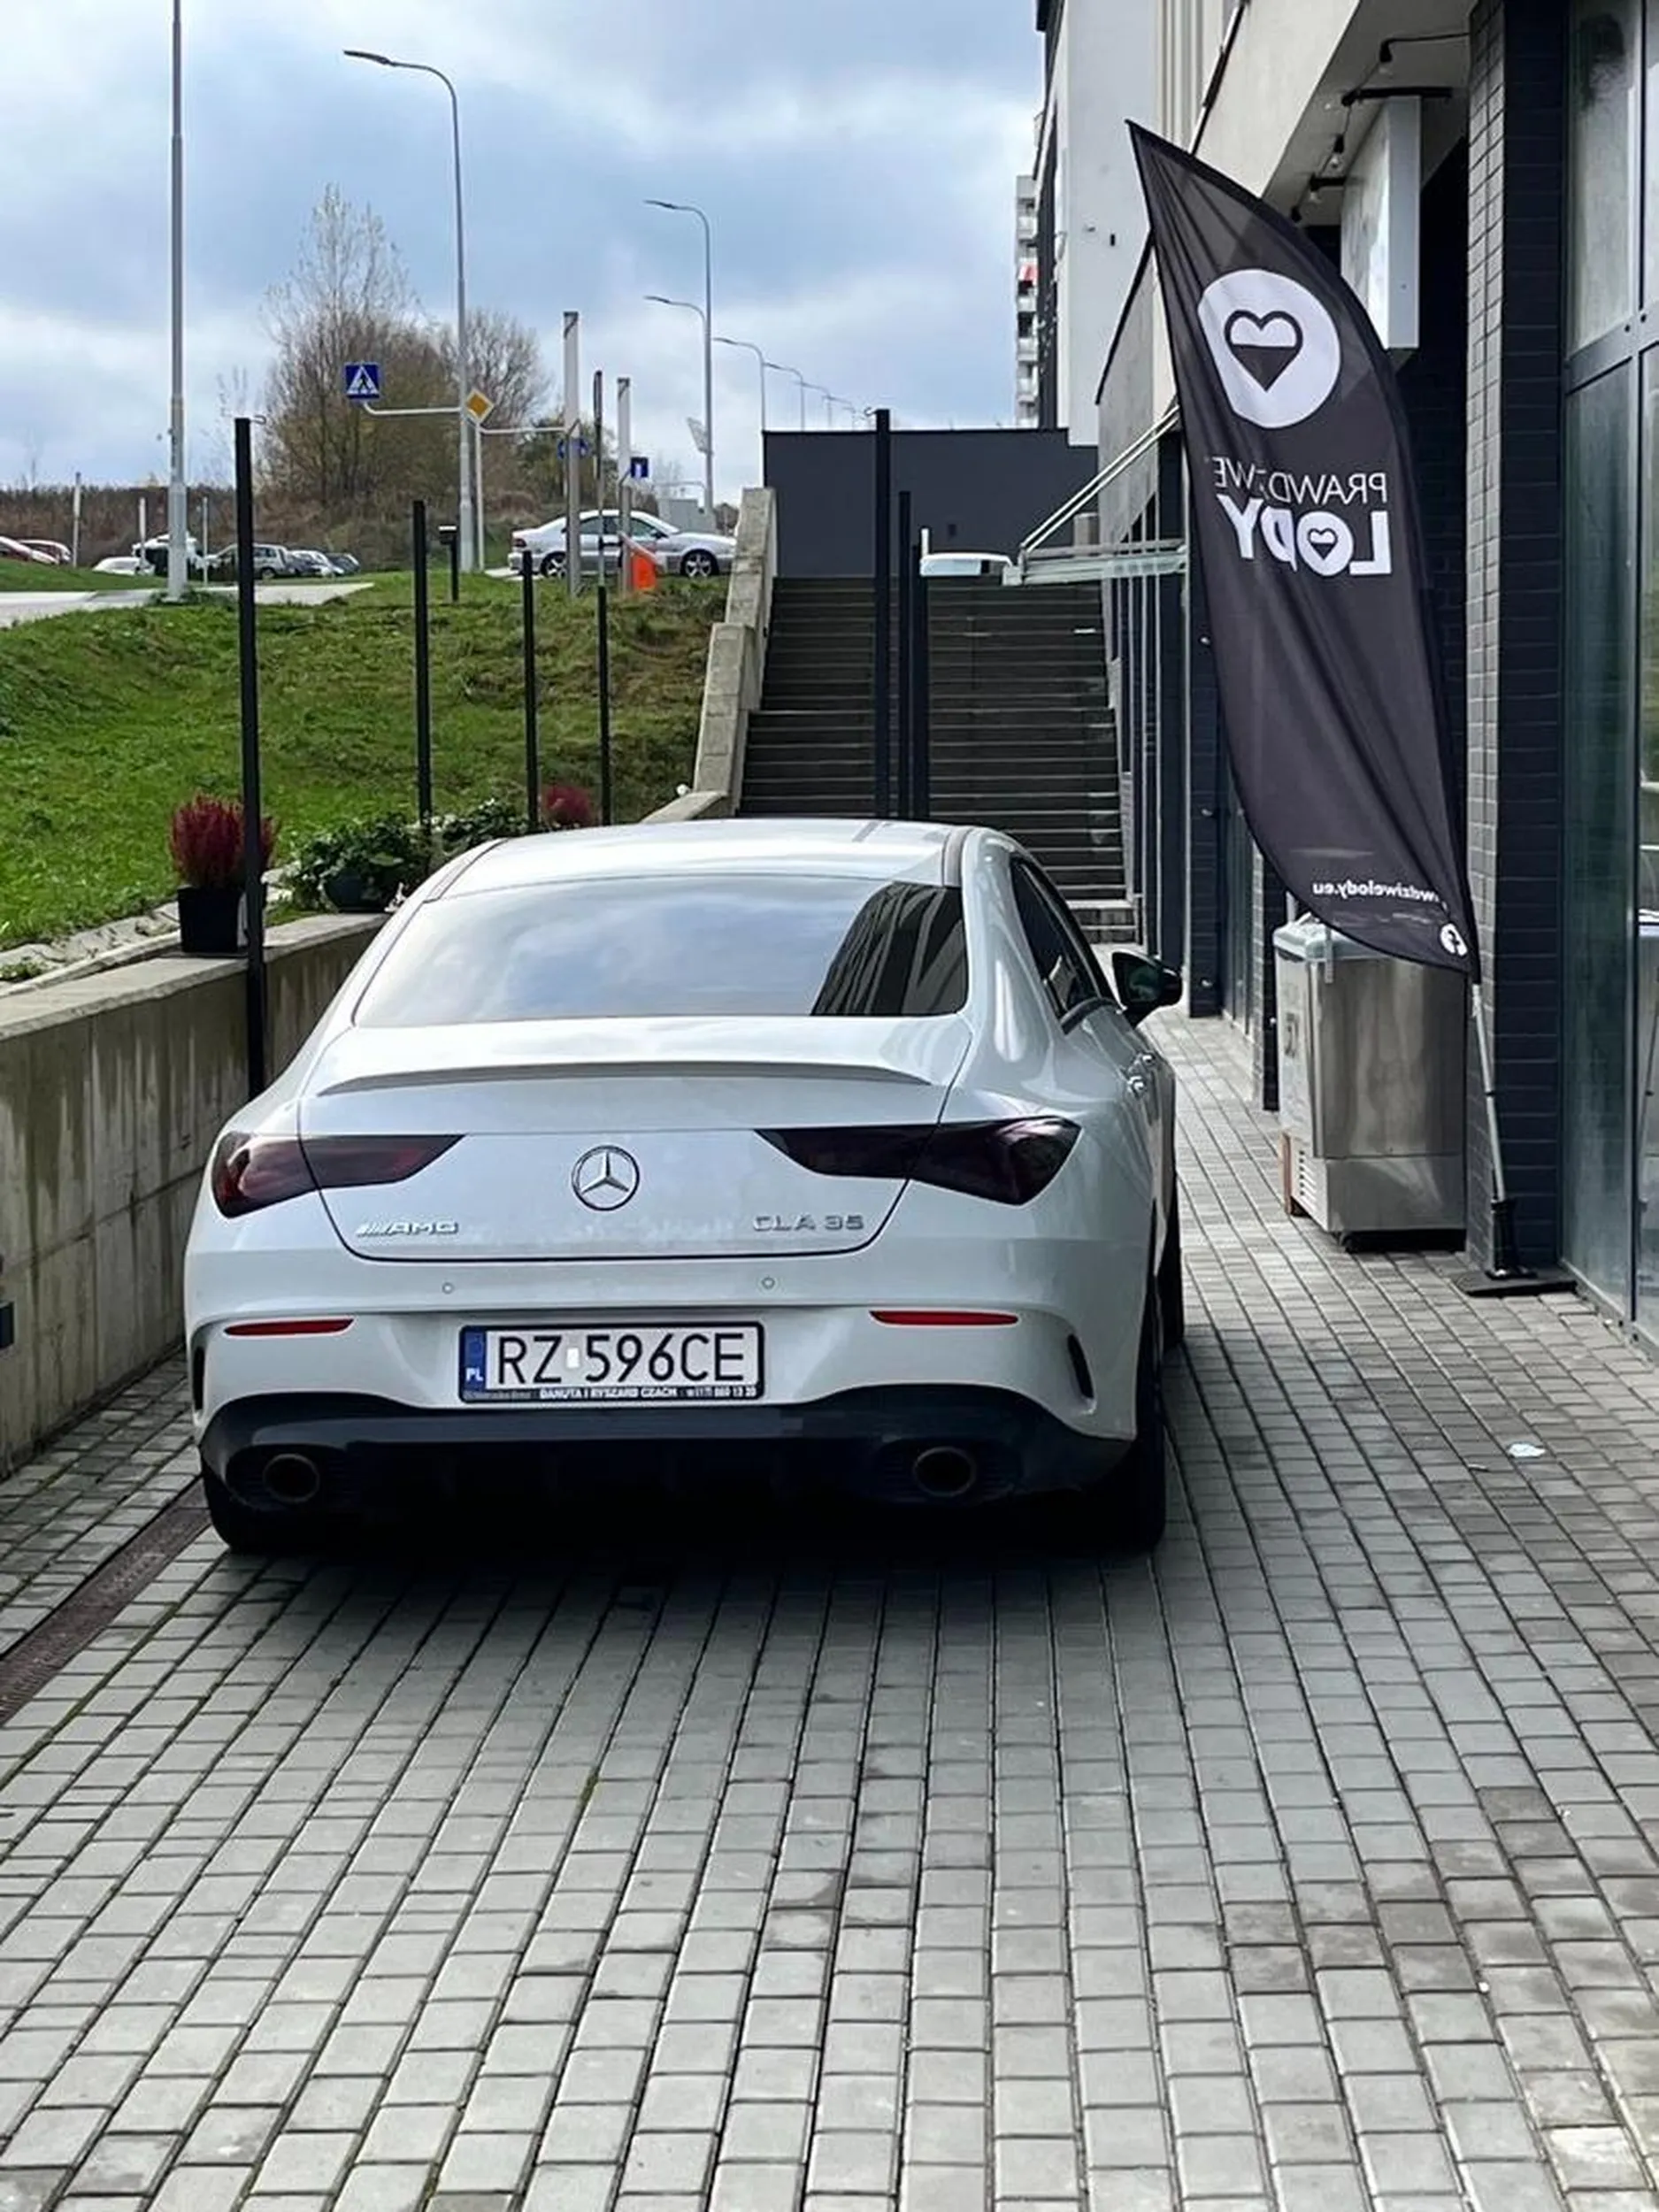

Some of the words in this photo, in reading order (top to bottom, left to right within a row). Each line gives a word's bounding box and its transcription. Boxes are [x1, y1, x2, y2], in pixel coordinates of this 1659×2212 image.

[753, 1214, 816, 1232] CLA
[824, 1214, 864, 1231] 35
[497, 1334, 563, 1385] RZ
[585, 1332, 745, 1384] 596CE
[465, 1368, 484, 1382] PL
